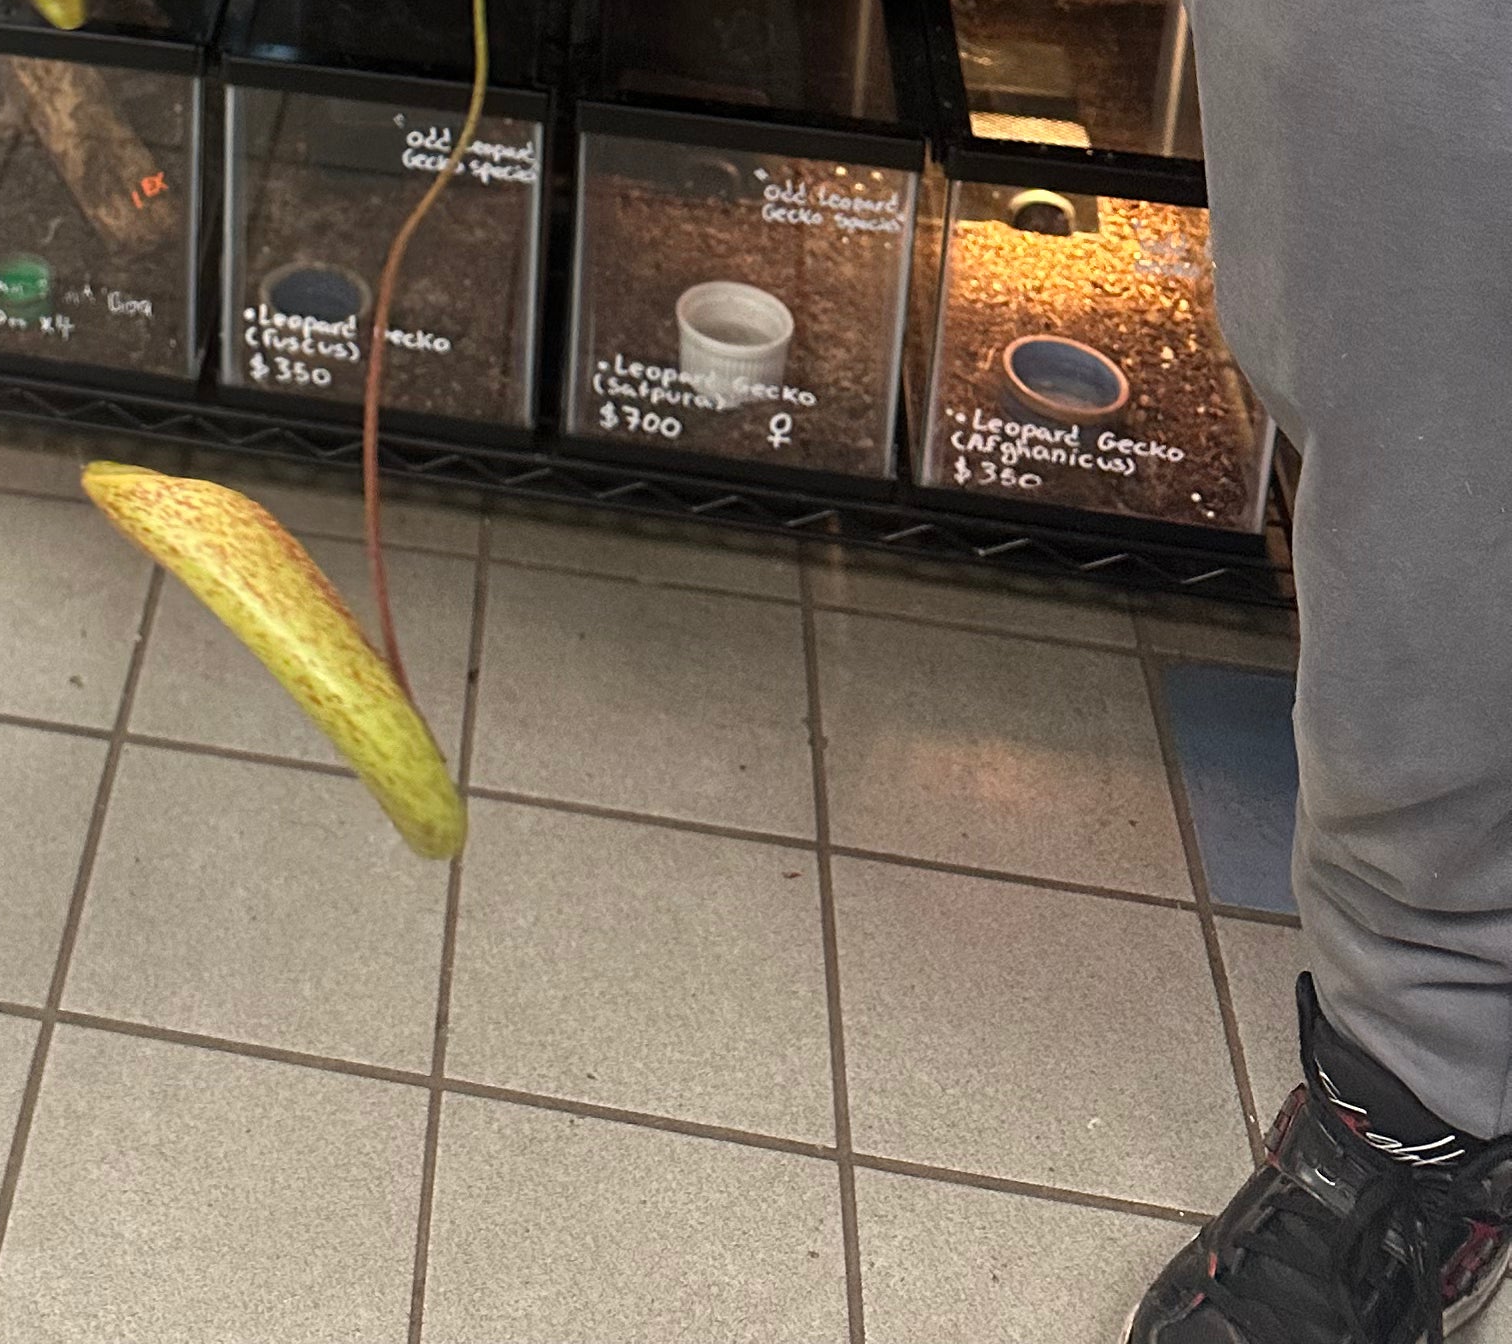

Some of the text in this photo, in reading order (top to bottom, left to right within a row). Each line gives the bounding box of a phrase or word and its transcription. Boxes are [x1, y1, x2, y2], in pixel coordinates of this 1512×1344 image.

[258, 302, 452, 354] Leopard ecko
[249, 351, 333, 387] $350
[593, 372, 725, 412] (Satpura)
[614, 352, 818, 408] Leopard Gecko
[598, 399, 683, 440] $700
[972, 407, 1186, 463] Leopard Gecko
